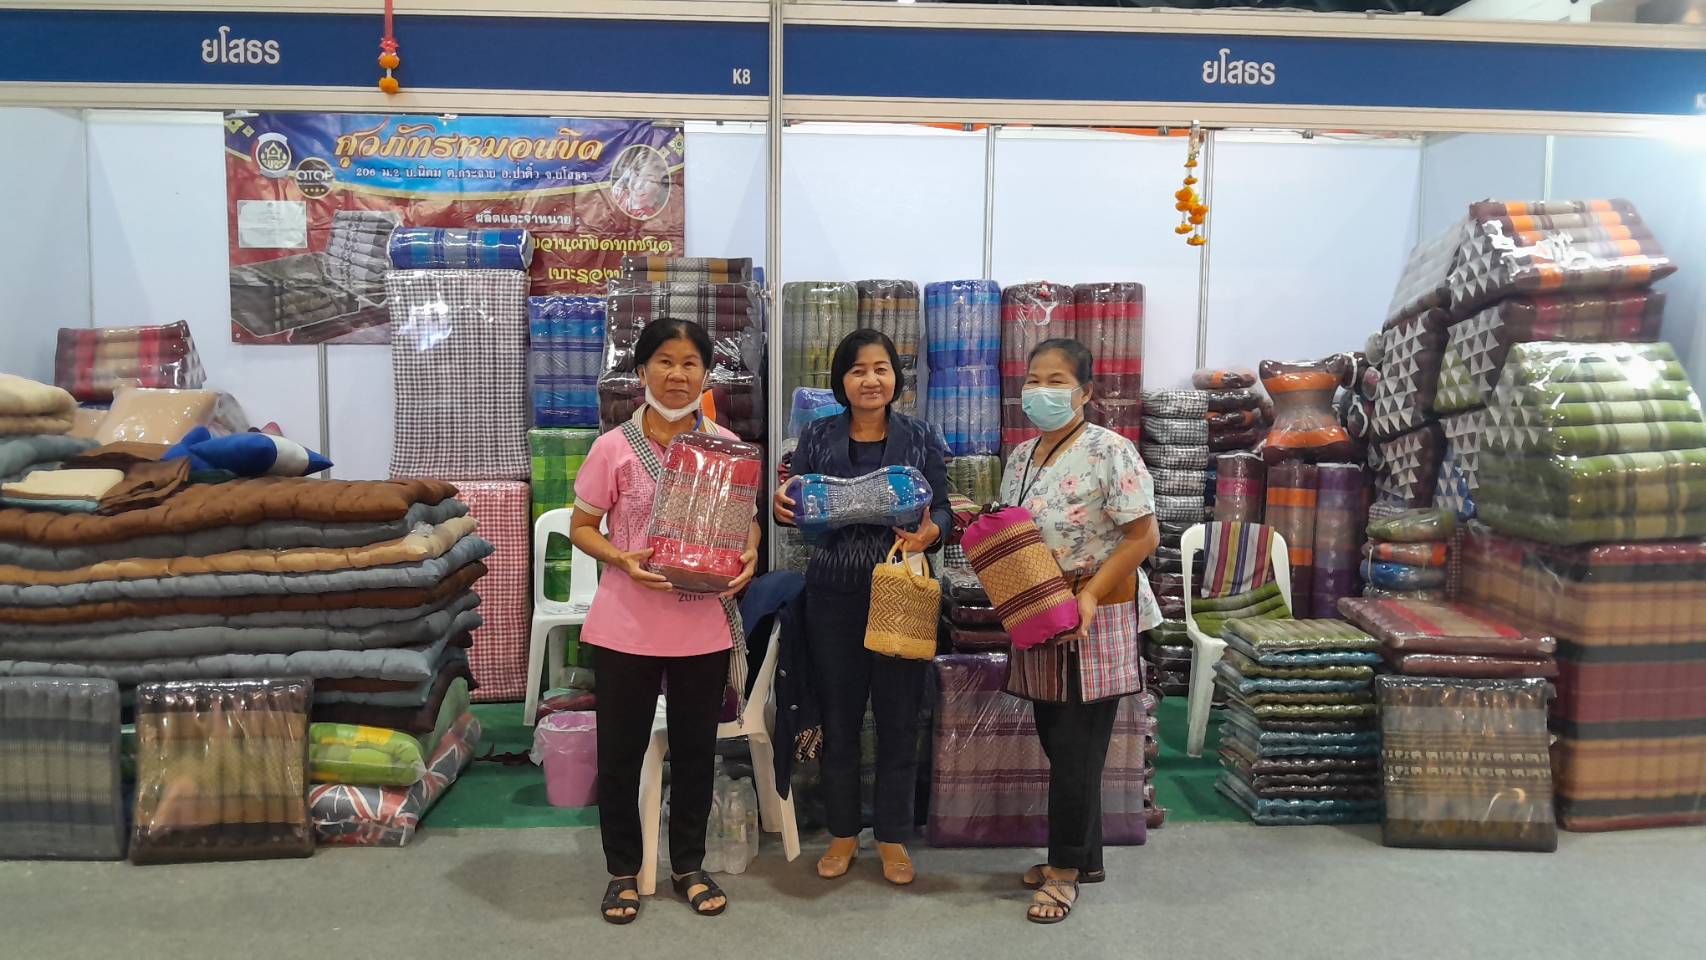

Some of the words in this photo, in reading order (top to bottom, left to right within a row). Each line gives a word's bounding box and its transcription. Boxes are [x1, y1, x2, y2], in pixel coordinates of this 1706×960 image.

[202, 25, 280, 64] ยโสธร
[1203, 48, 1275, 85] ยโสธร
[733, 68, 751, 84] K8
[297, 170, 332, 181] OTOP
[355, 167, 376, 177] 206
[381, 167, 400, 177] ม.2
